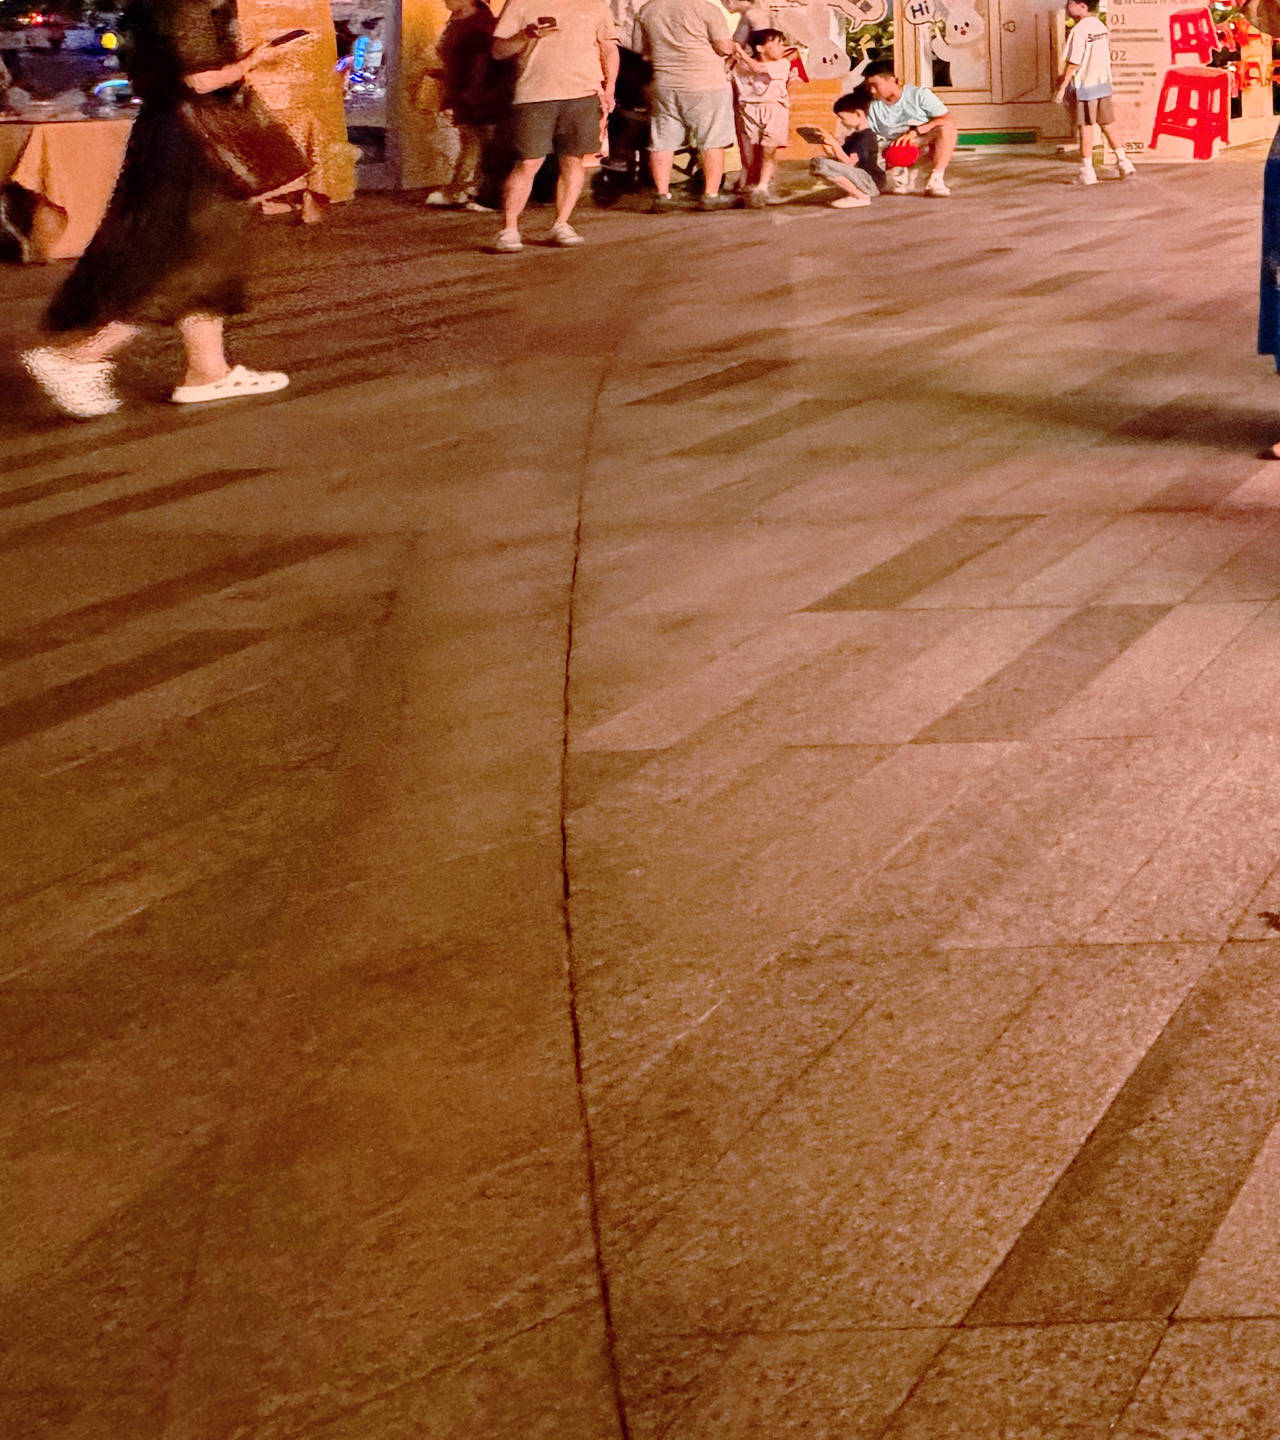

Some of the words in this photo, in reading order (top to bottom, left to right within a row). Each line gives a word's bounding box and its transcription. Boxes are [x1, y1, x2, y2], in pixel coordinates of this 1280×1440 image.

[910, 0, 930, 19] Hi
[1110, 13, 1127, 25] 01
[1110, 49, 1127, 62] 02
